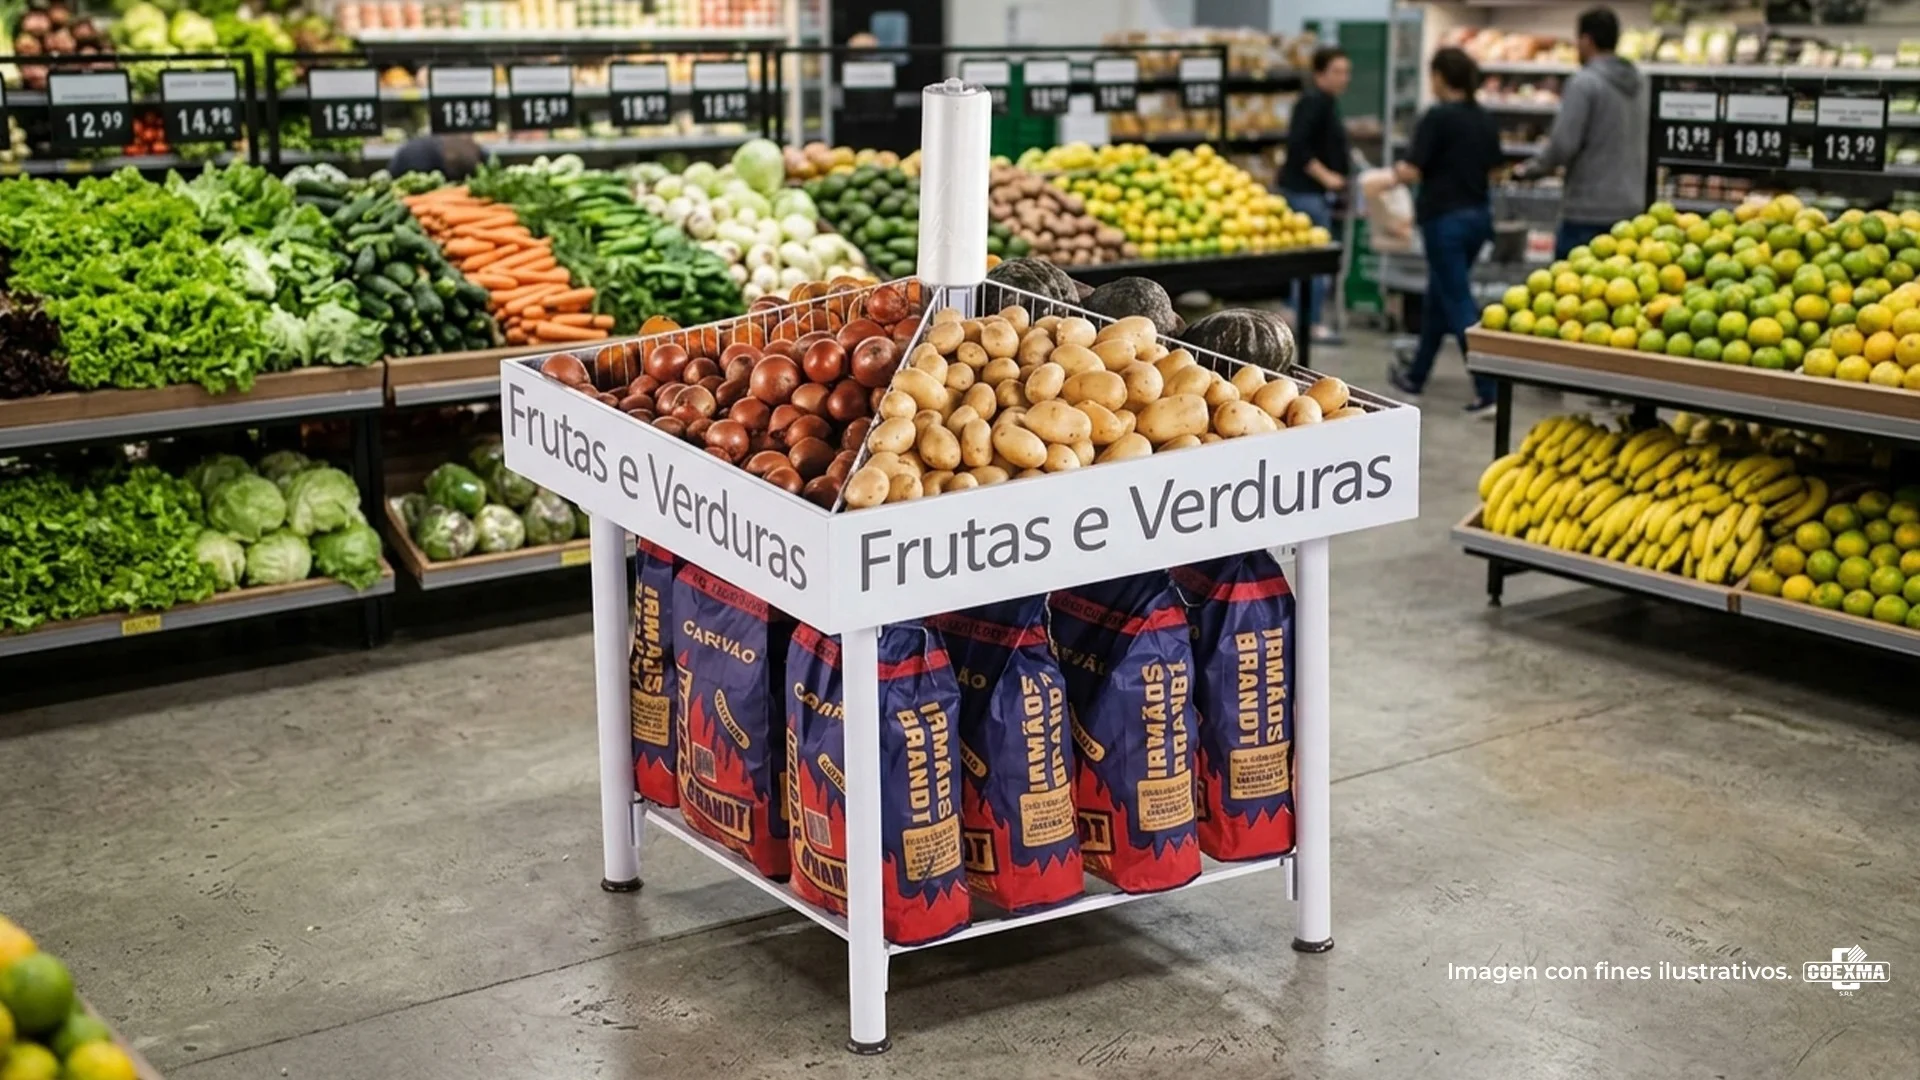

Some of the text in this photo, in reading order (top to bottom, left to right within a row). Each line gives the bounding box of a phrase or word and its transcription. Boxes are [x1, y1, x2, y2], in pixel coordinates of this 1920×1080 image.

[66, 111, 123, 139] 12.99
[1825, 134, 1875, 161] 13.99
[508, 382, 808, 591] Frutas e Verduras
[860, 453, 1393, 593] Frutas e Verduras
[1235, 632, 1259, 745] BRANDT
[897, 709, 932, 824] BRANDT
